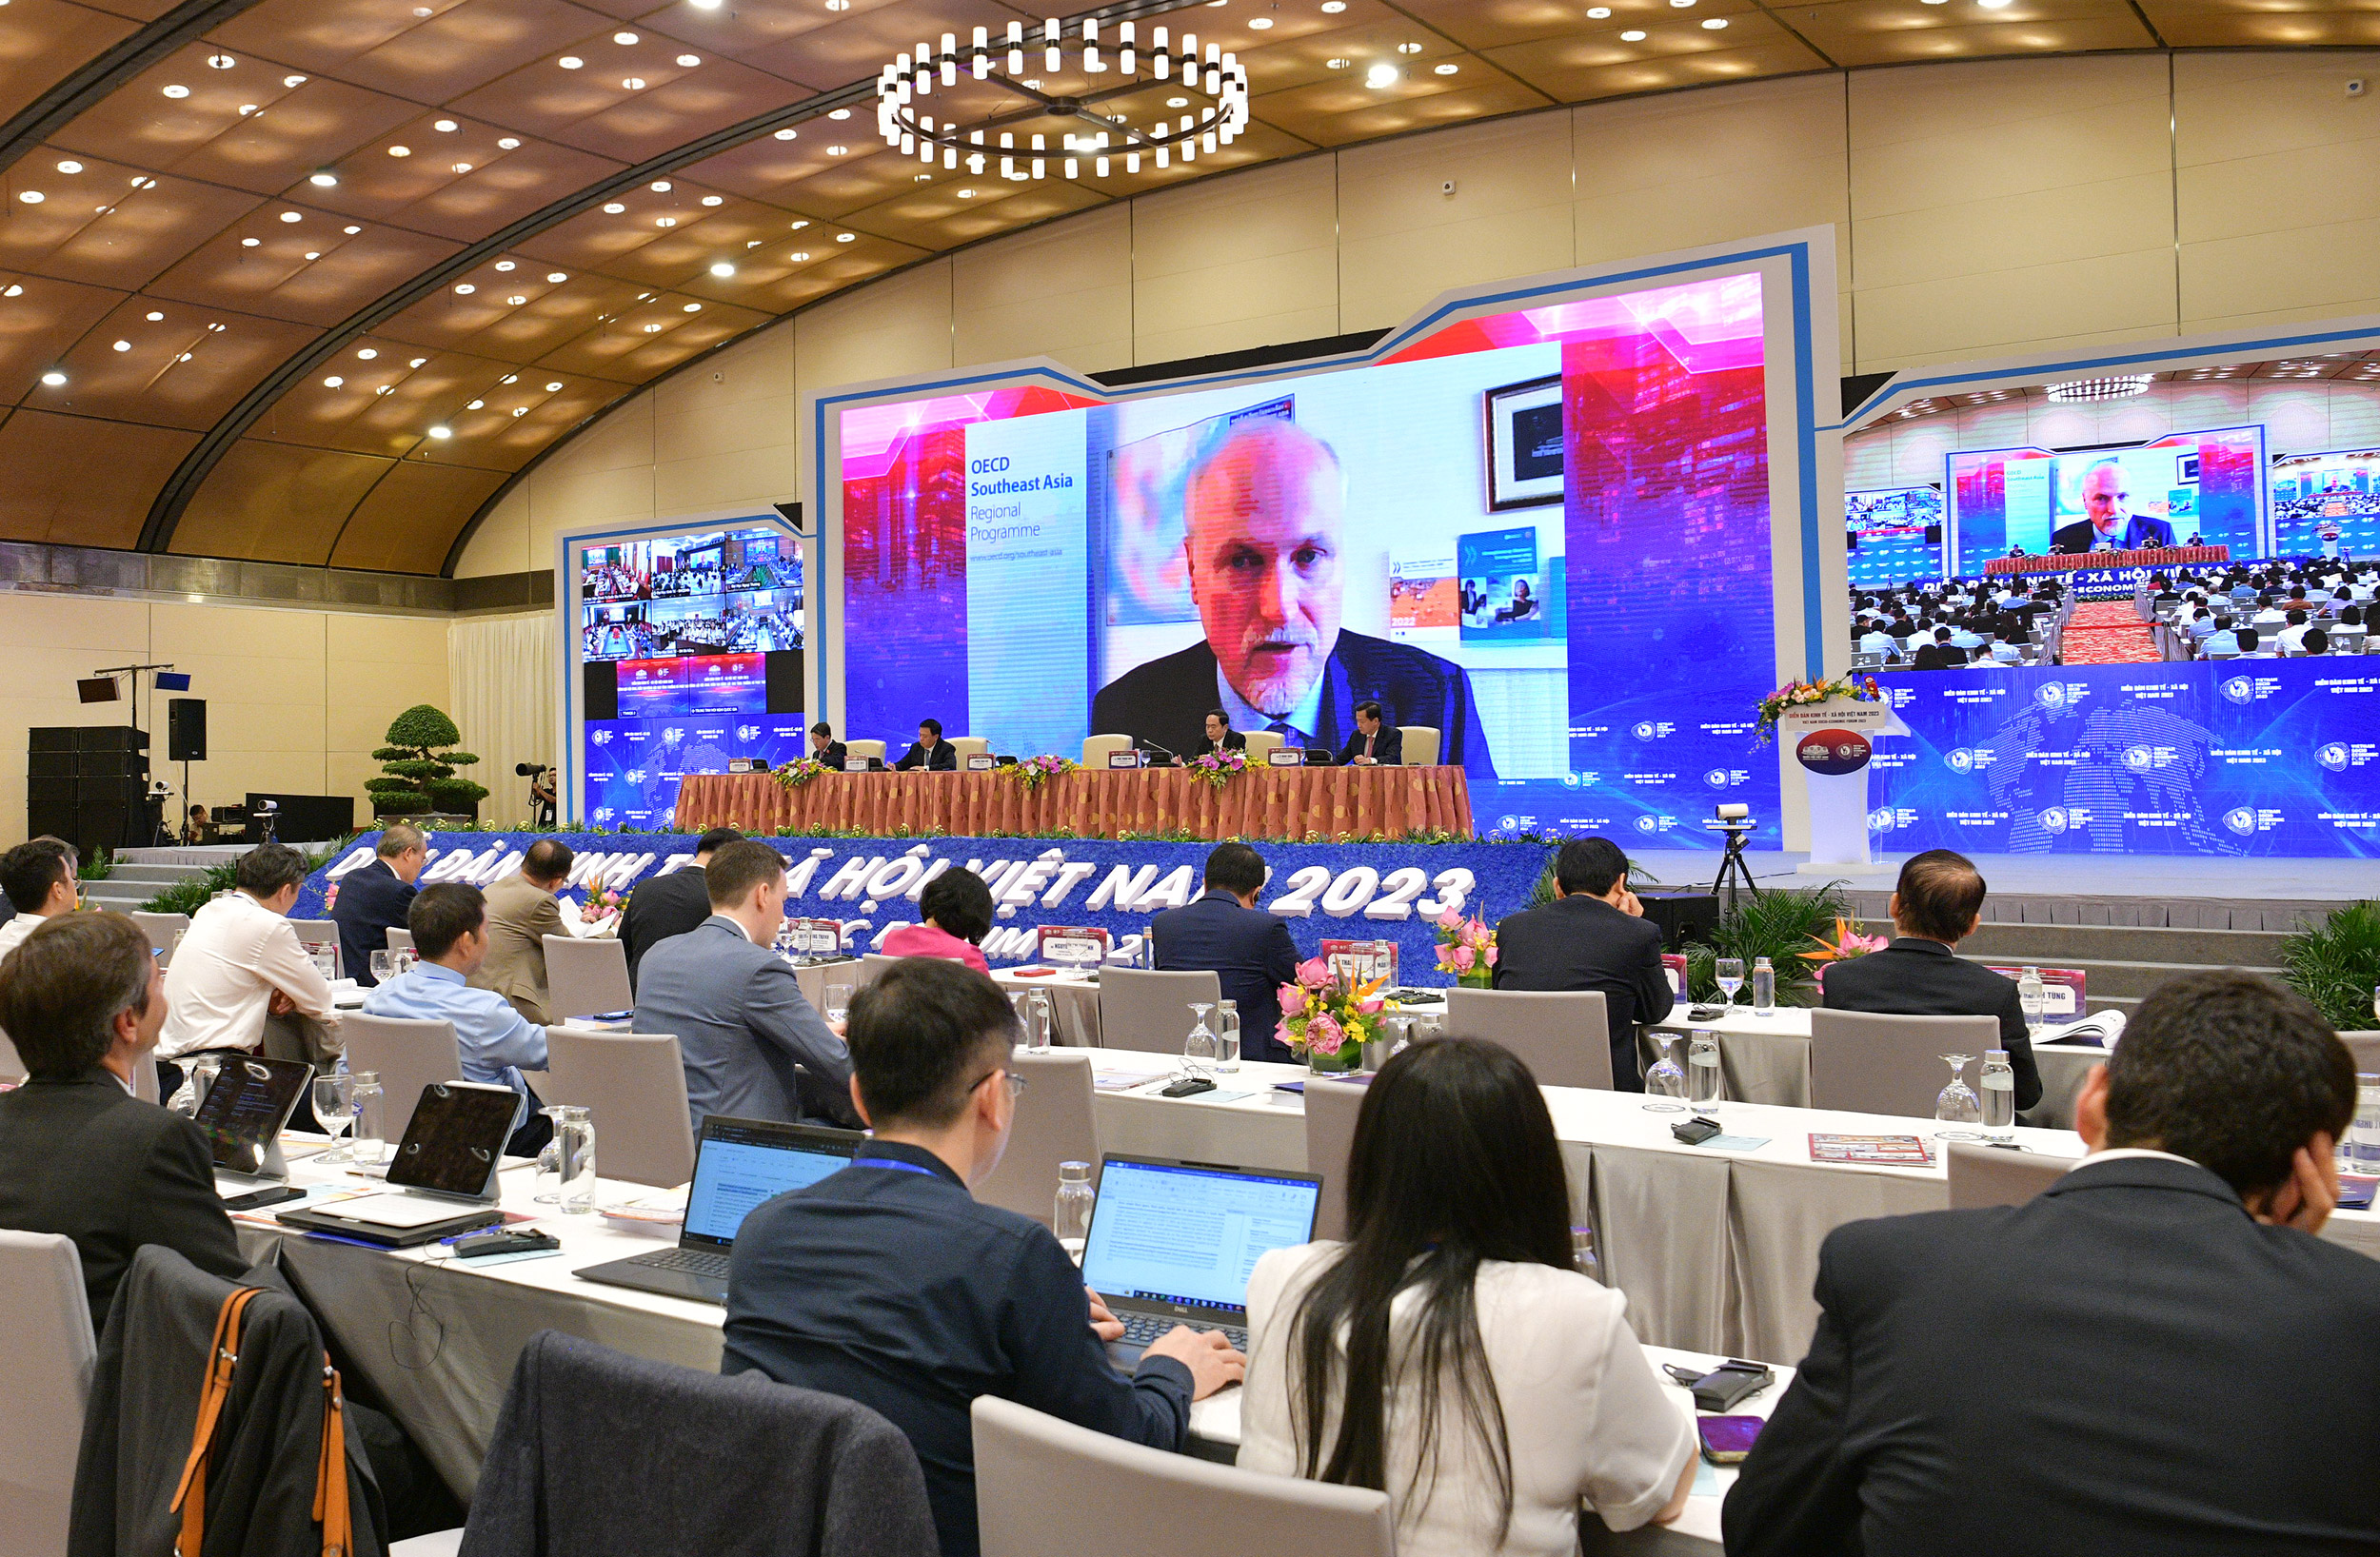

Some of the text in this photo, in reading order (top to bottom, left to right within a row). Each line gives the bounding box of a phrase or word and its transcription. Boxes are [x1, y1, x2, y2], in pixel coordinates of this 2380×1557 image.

[971, 457, 1009, 474] OECD
[971, 473, 1072, 496] Southeast Asia
[971, 502, 1021, 523] Regional
[971, 524, 1041, 543] Programme
[1392, 616, 1417, 626] 2022
[563, 852, 657, 892] INH
[818, 844, 951, 915] HỘI
[1268, 865, 1478, 924] 2023
